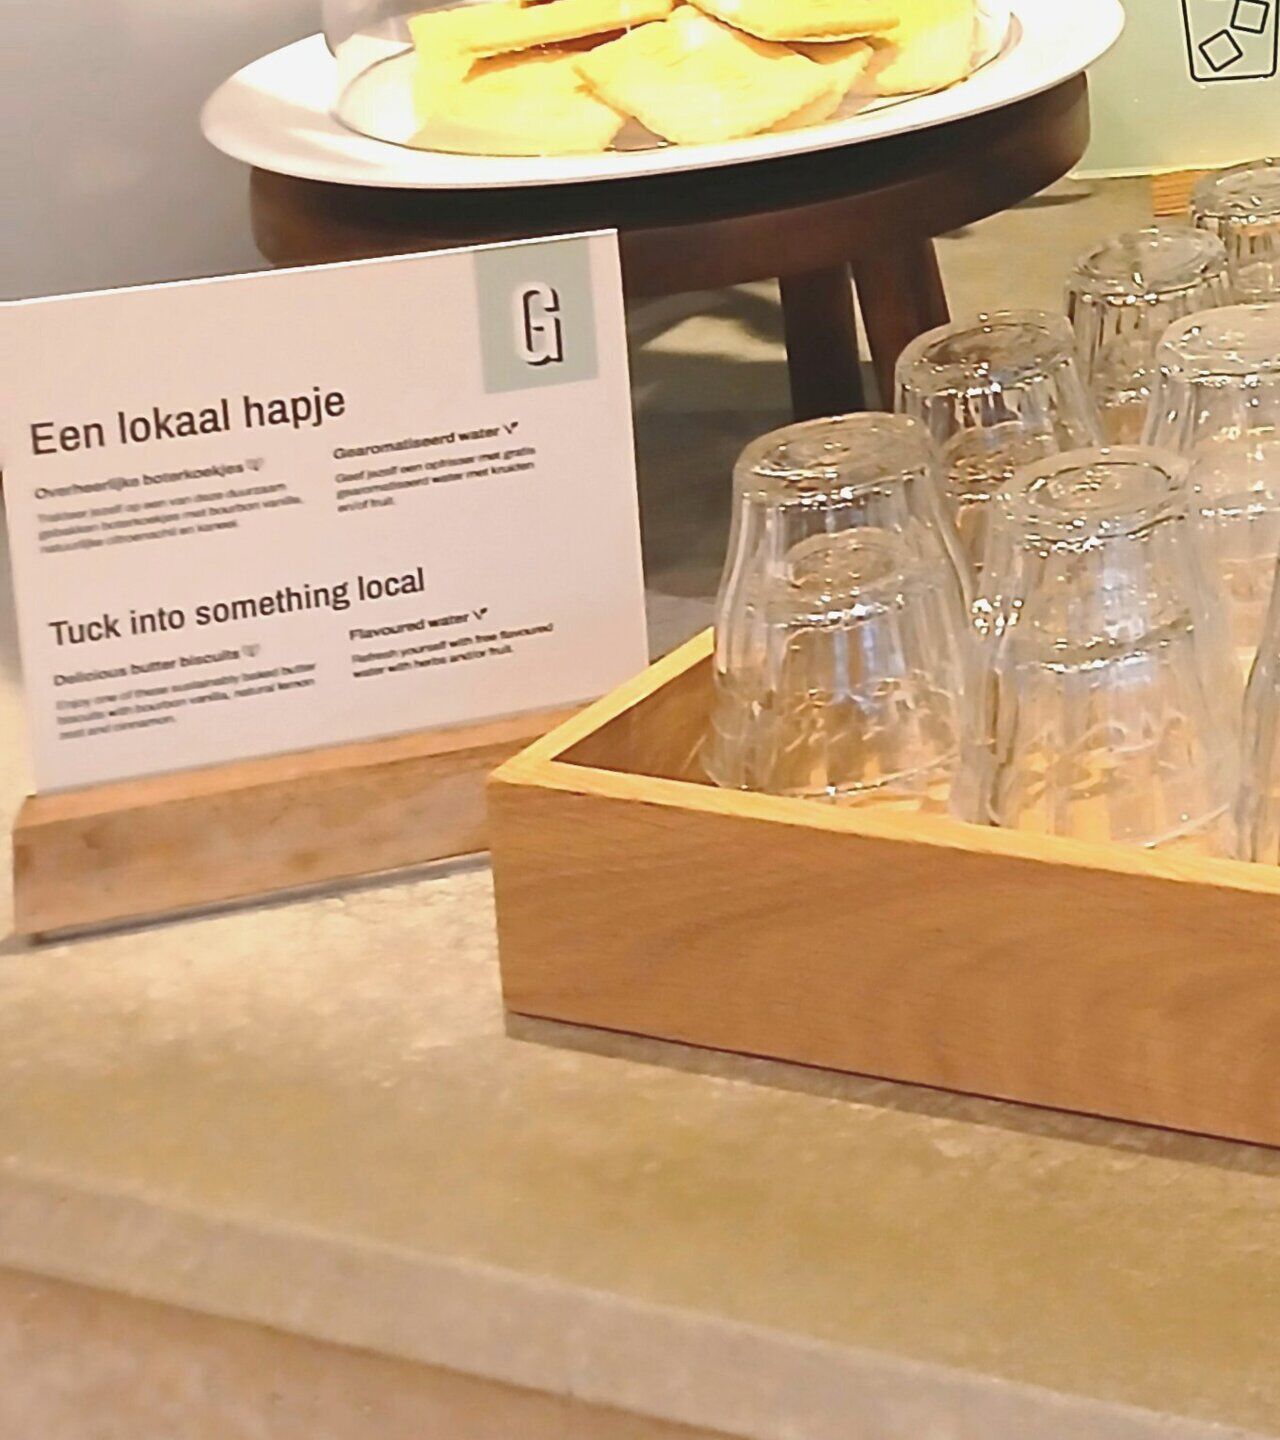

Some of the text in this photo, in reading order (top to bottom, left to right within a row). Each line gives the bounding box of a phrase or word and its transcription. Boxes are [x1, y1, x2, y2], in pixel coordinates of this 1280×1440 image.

[520, 283, 564, 365] G
[30, 386, 346, 455] Een lokaal hapje
[333, 427, 499, 459] Gearomatiseerd water
[49, 567, 424, 646] Tuck into something local
[349, 614, 469, 640] Flavoured water
